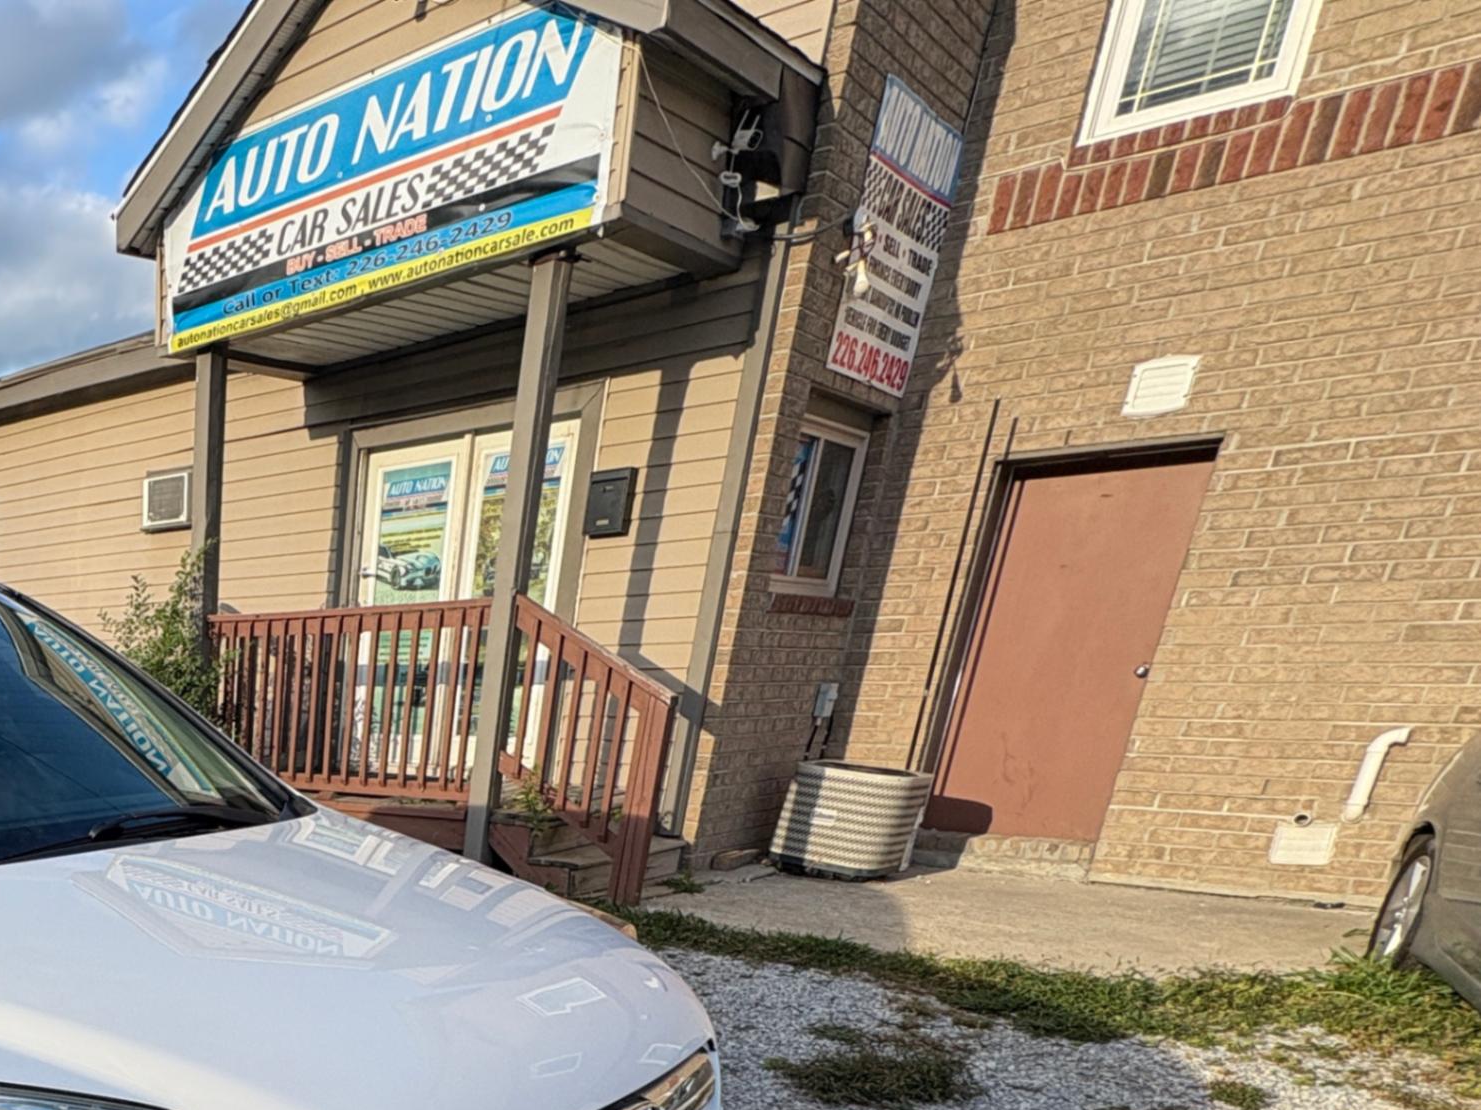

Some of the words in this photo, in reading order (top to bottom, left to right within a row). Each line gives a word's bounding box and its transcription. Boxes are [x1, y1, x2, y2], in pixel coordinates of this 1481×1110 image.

[205, 113, 339, 222] AUTO
[352, 19, 584, 166] NATION
[276, 208, 329, 256] CAR
[336, 173, 425, 236] SALES
[286, 249, 317, 276] BUY
[325, 236, 363, 263] SELL
[374, 213, 428, 246] TRADE
[177, 283, 357, 348] autonationcarsales@gmail.com
[367, 217, 575, 291] www.autonationcarsale.com
[223, 289, 256, 316] Call
[262, 286, 282, 303] or
[344, 210, 513, 277] 226-246-2429
[906, 247, 934, 277] TRADE
[831, 329, 910, 392] 226.246.2429
[390, 479, 412, 496] AUTO
